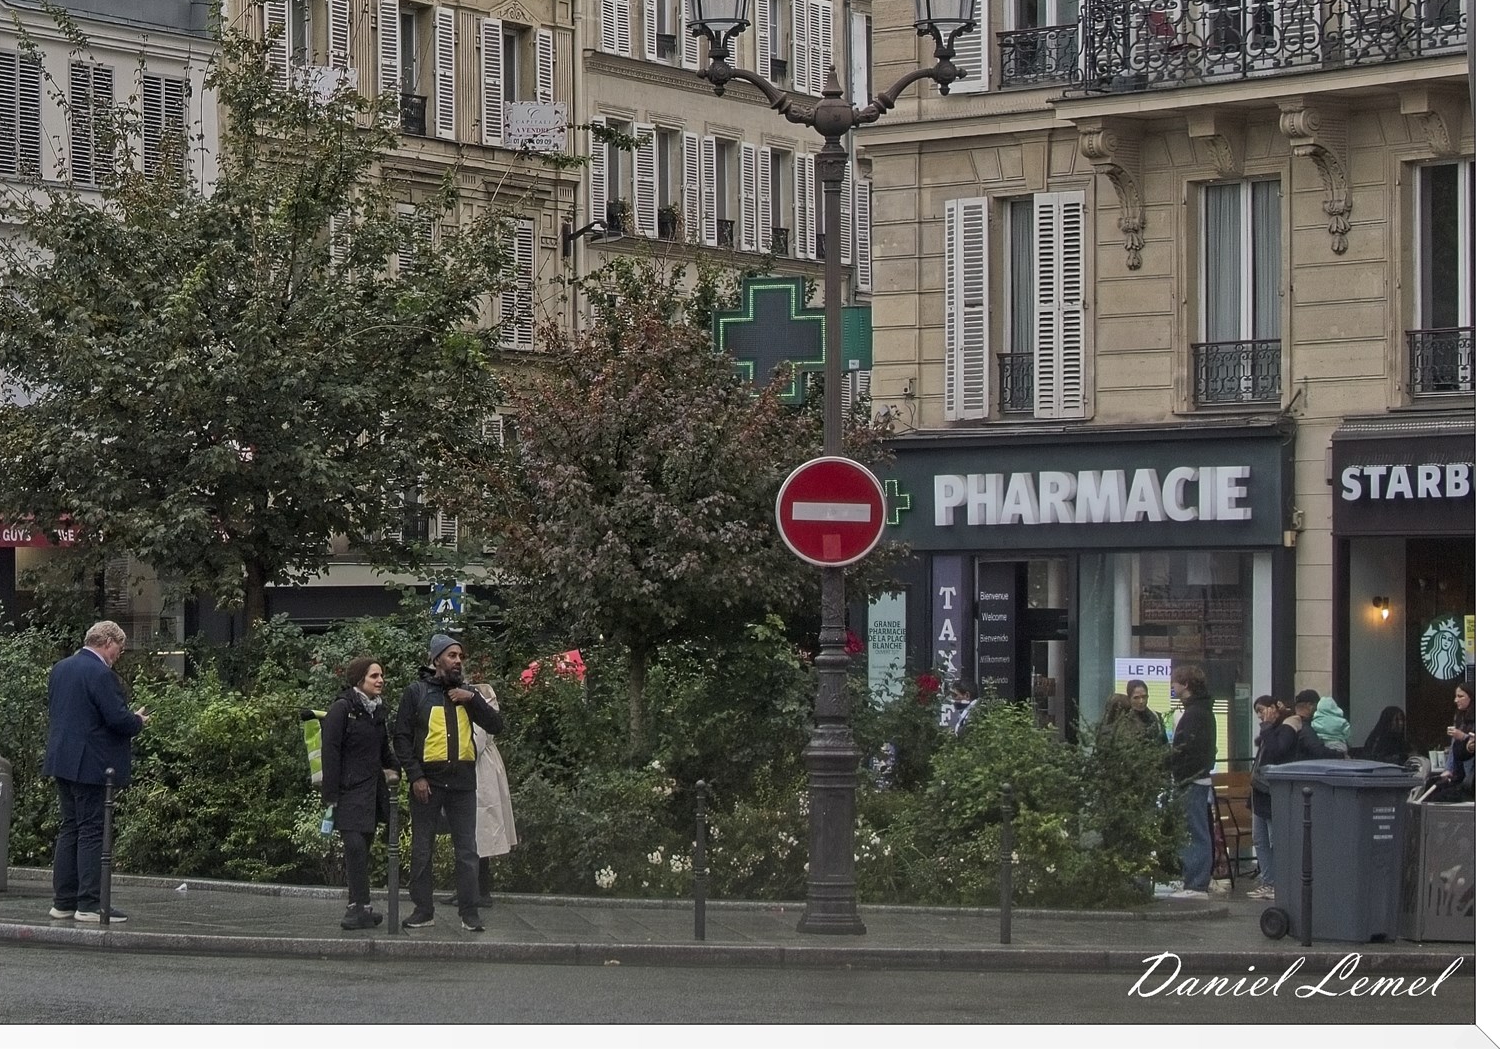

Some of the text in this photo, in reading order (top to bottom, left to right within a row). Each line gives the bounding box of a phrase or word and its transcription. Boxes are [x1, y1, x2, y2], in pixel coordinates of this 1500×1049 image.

[1341, 464, 1476, 501] STARB
[934, 466, 1252, 526] PHARMACIE
[980, 591, 1009, 601] Bienvenue
[981, 612, 1008, 622] Welcome
[873, 620, 901, 628] GRANDE
[980, 633, 1009, 643] Bienvenido
[872, 642, 902, 650] BLANCHE
[1128, 665, 1144, 676] LE
